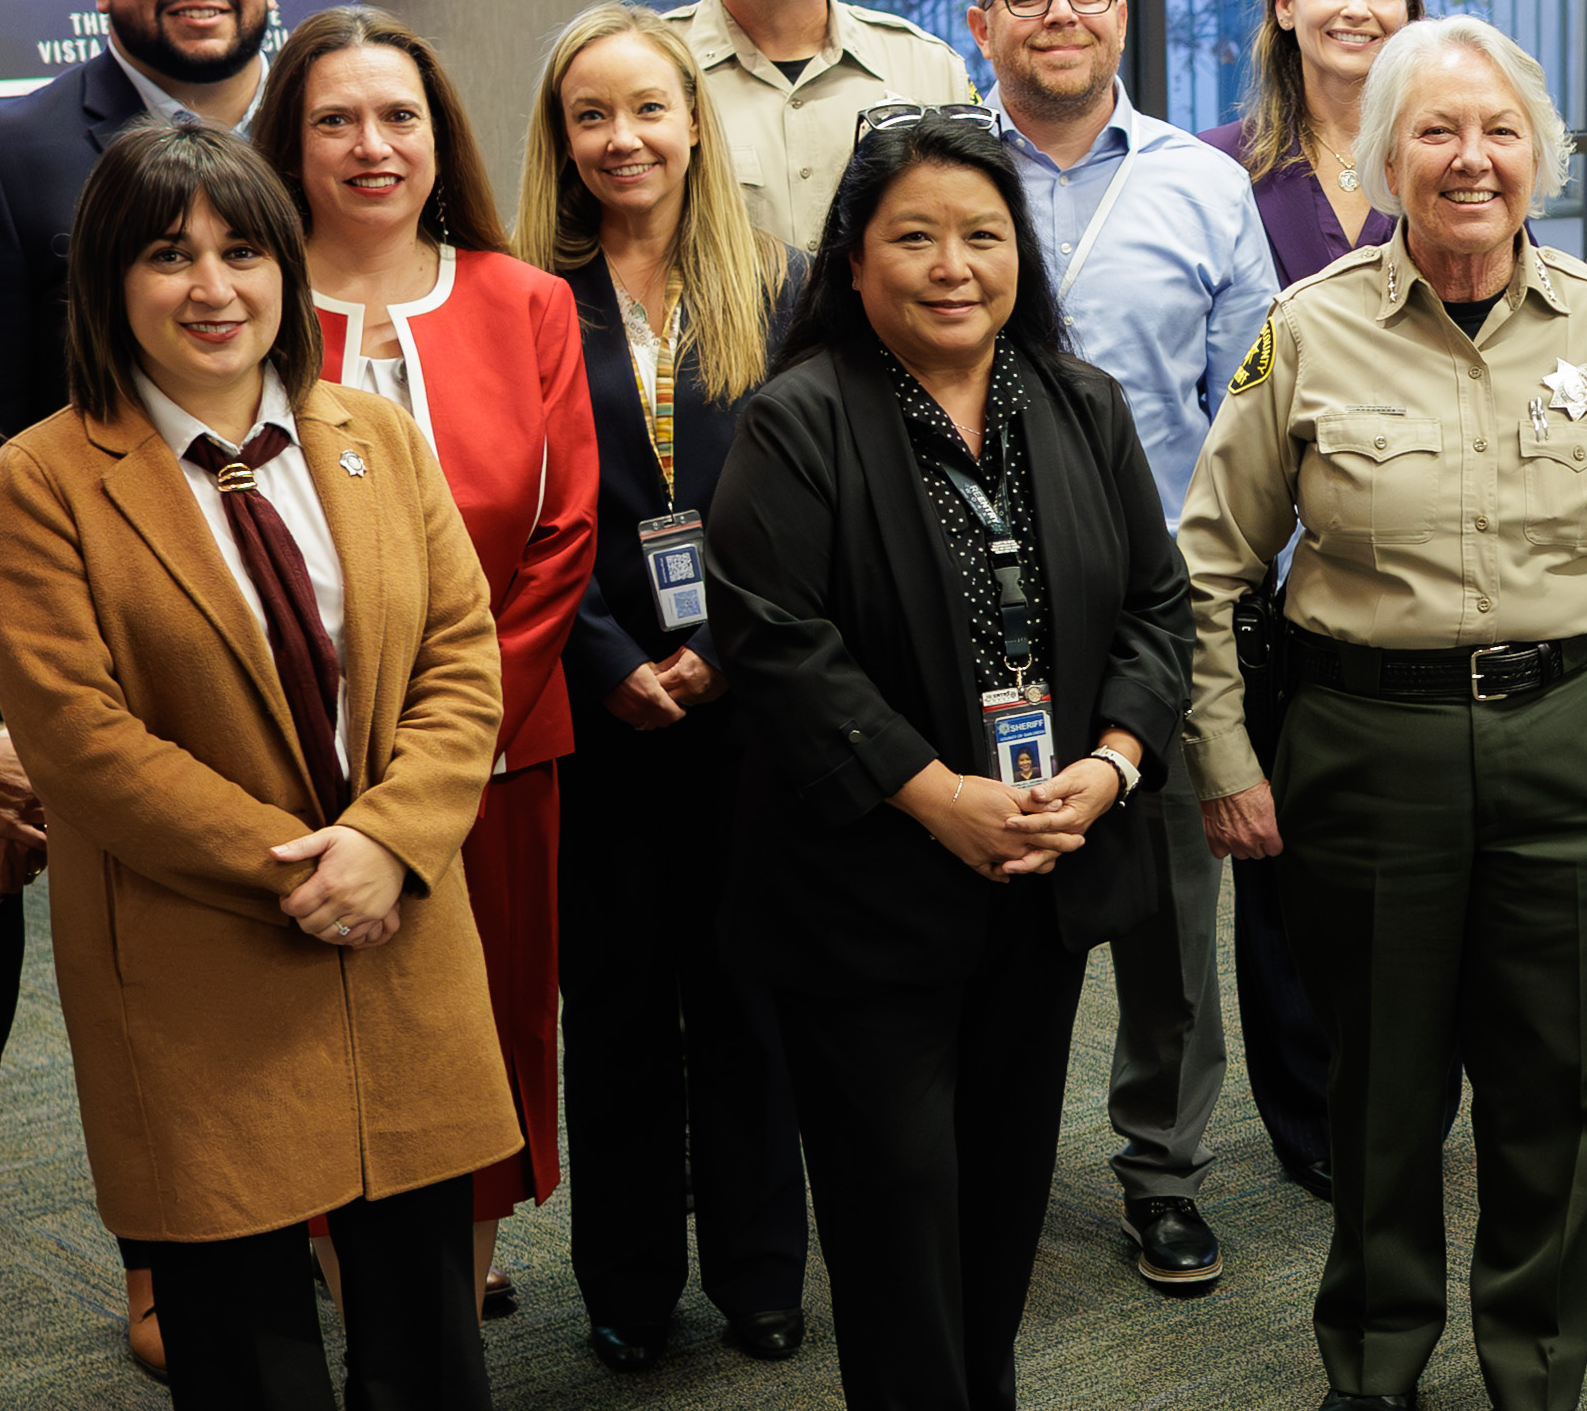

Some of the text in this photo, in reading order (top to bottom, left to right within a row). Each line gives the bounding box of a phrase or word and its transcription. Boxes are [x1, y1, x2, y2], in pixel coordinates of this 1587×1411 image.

[69, 12, 110, 36] THE
[37, 39, 103, 65] VISTA
[1257, 329, 1271, 375] COUNTY
[969, 484, 1002, 524] REENTRY
[1010, 719, 1044, 733] SHERIFF
